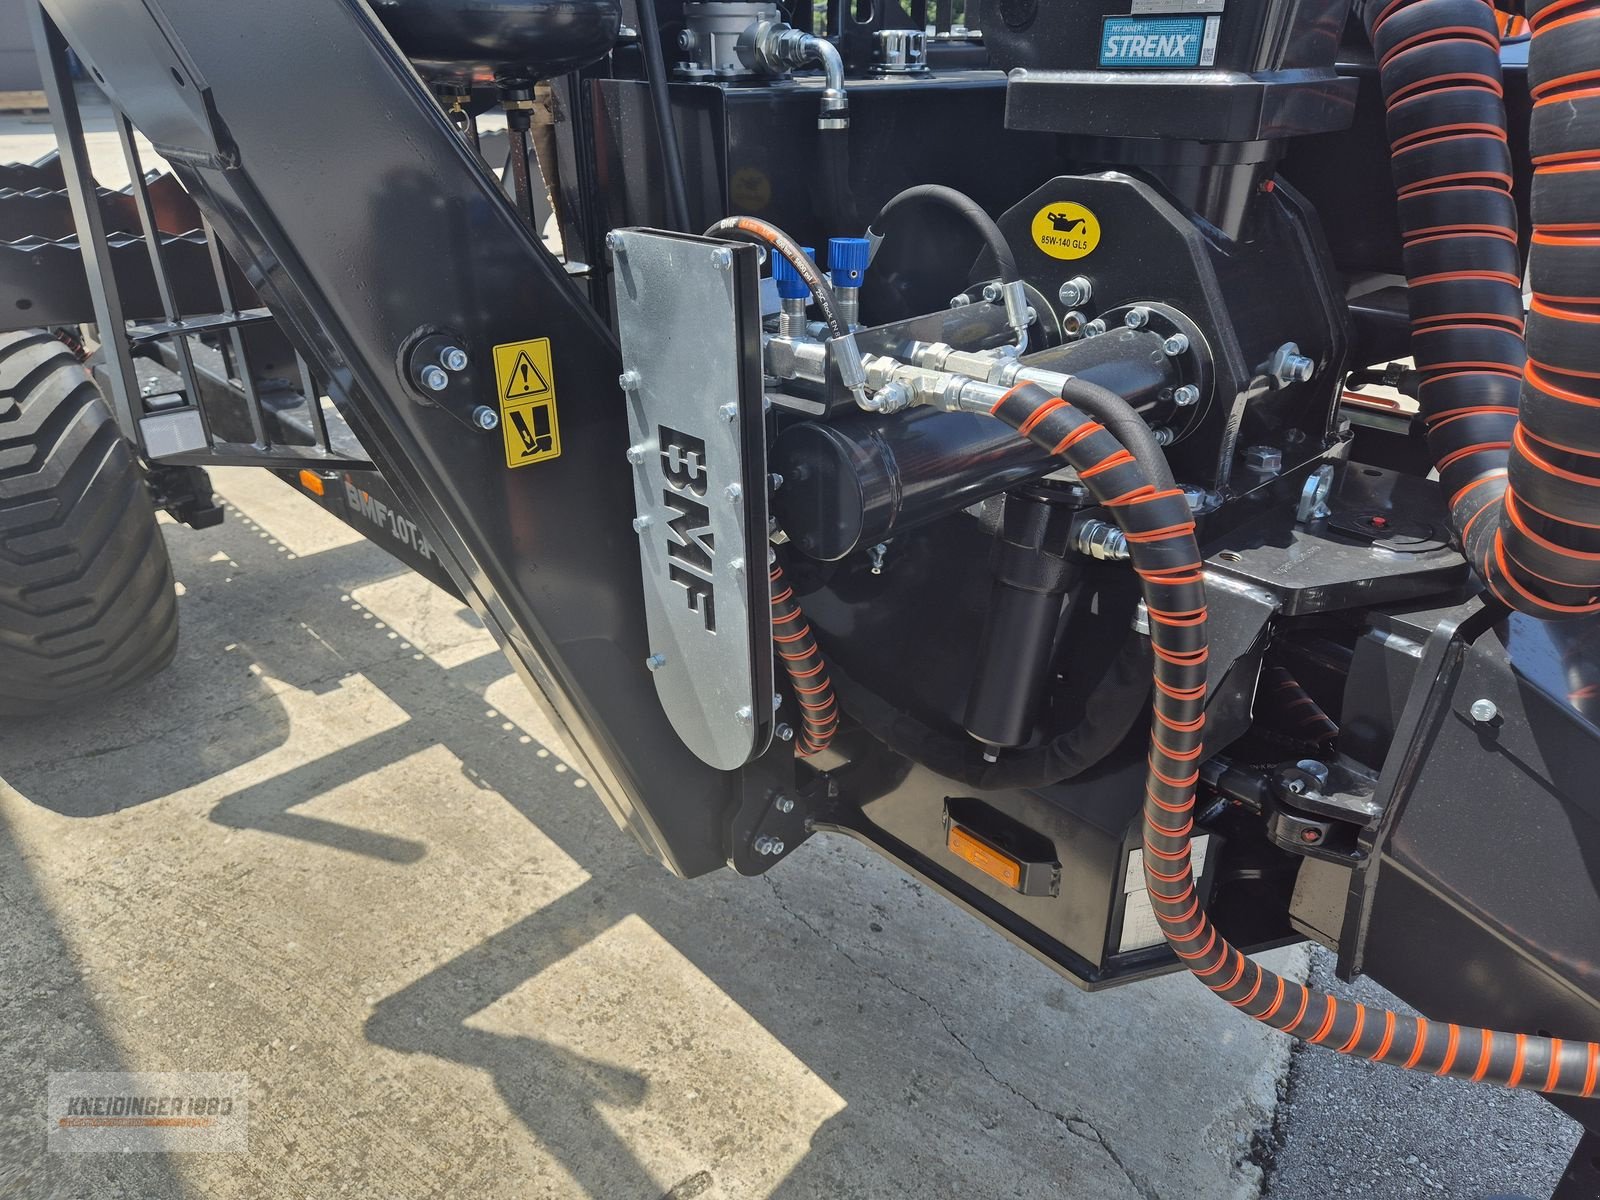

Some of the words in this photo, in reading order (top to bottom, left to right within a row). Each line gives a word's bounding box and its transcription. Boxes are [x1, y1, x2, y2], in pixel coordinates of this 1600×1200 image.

[720, 218, 739, 230] BMF
[1041, 235, 1071, 248] 85W-140
[1072, 239, 1088, 250] GL5
[815, 288, 826, 302] 2SC
[822, 301, 833, 319] Rock
[830, 320, 839, 332] EN
[344, 480, 388, 528] BMF
[657, 423, 718, 637] BMF
